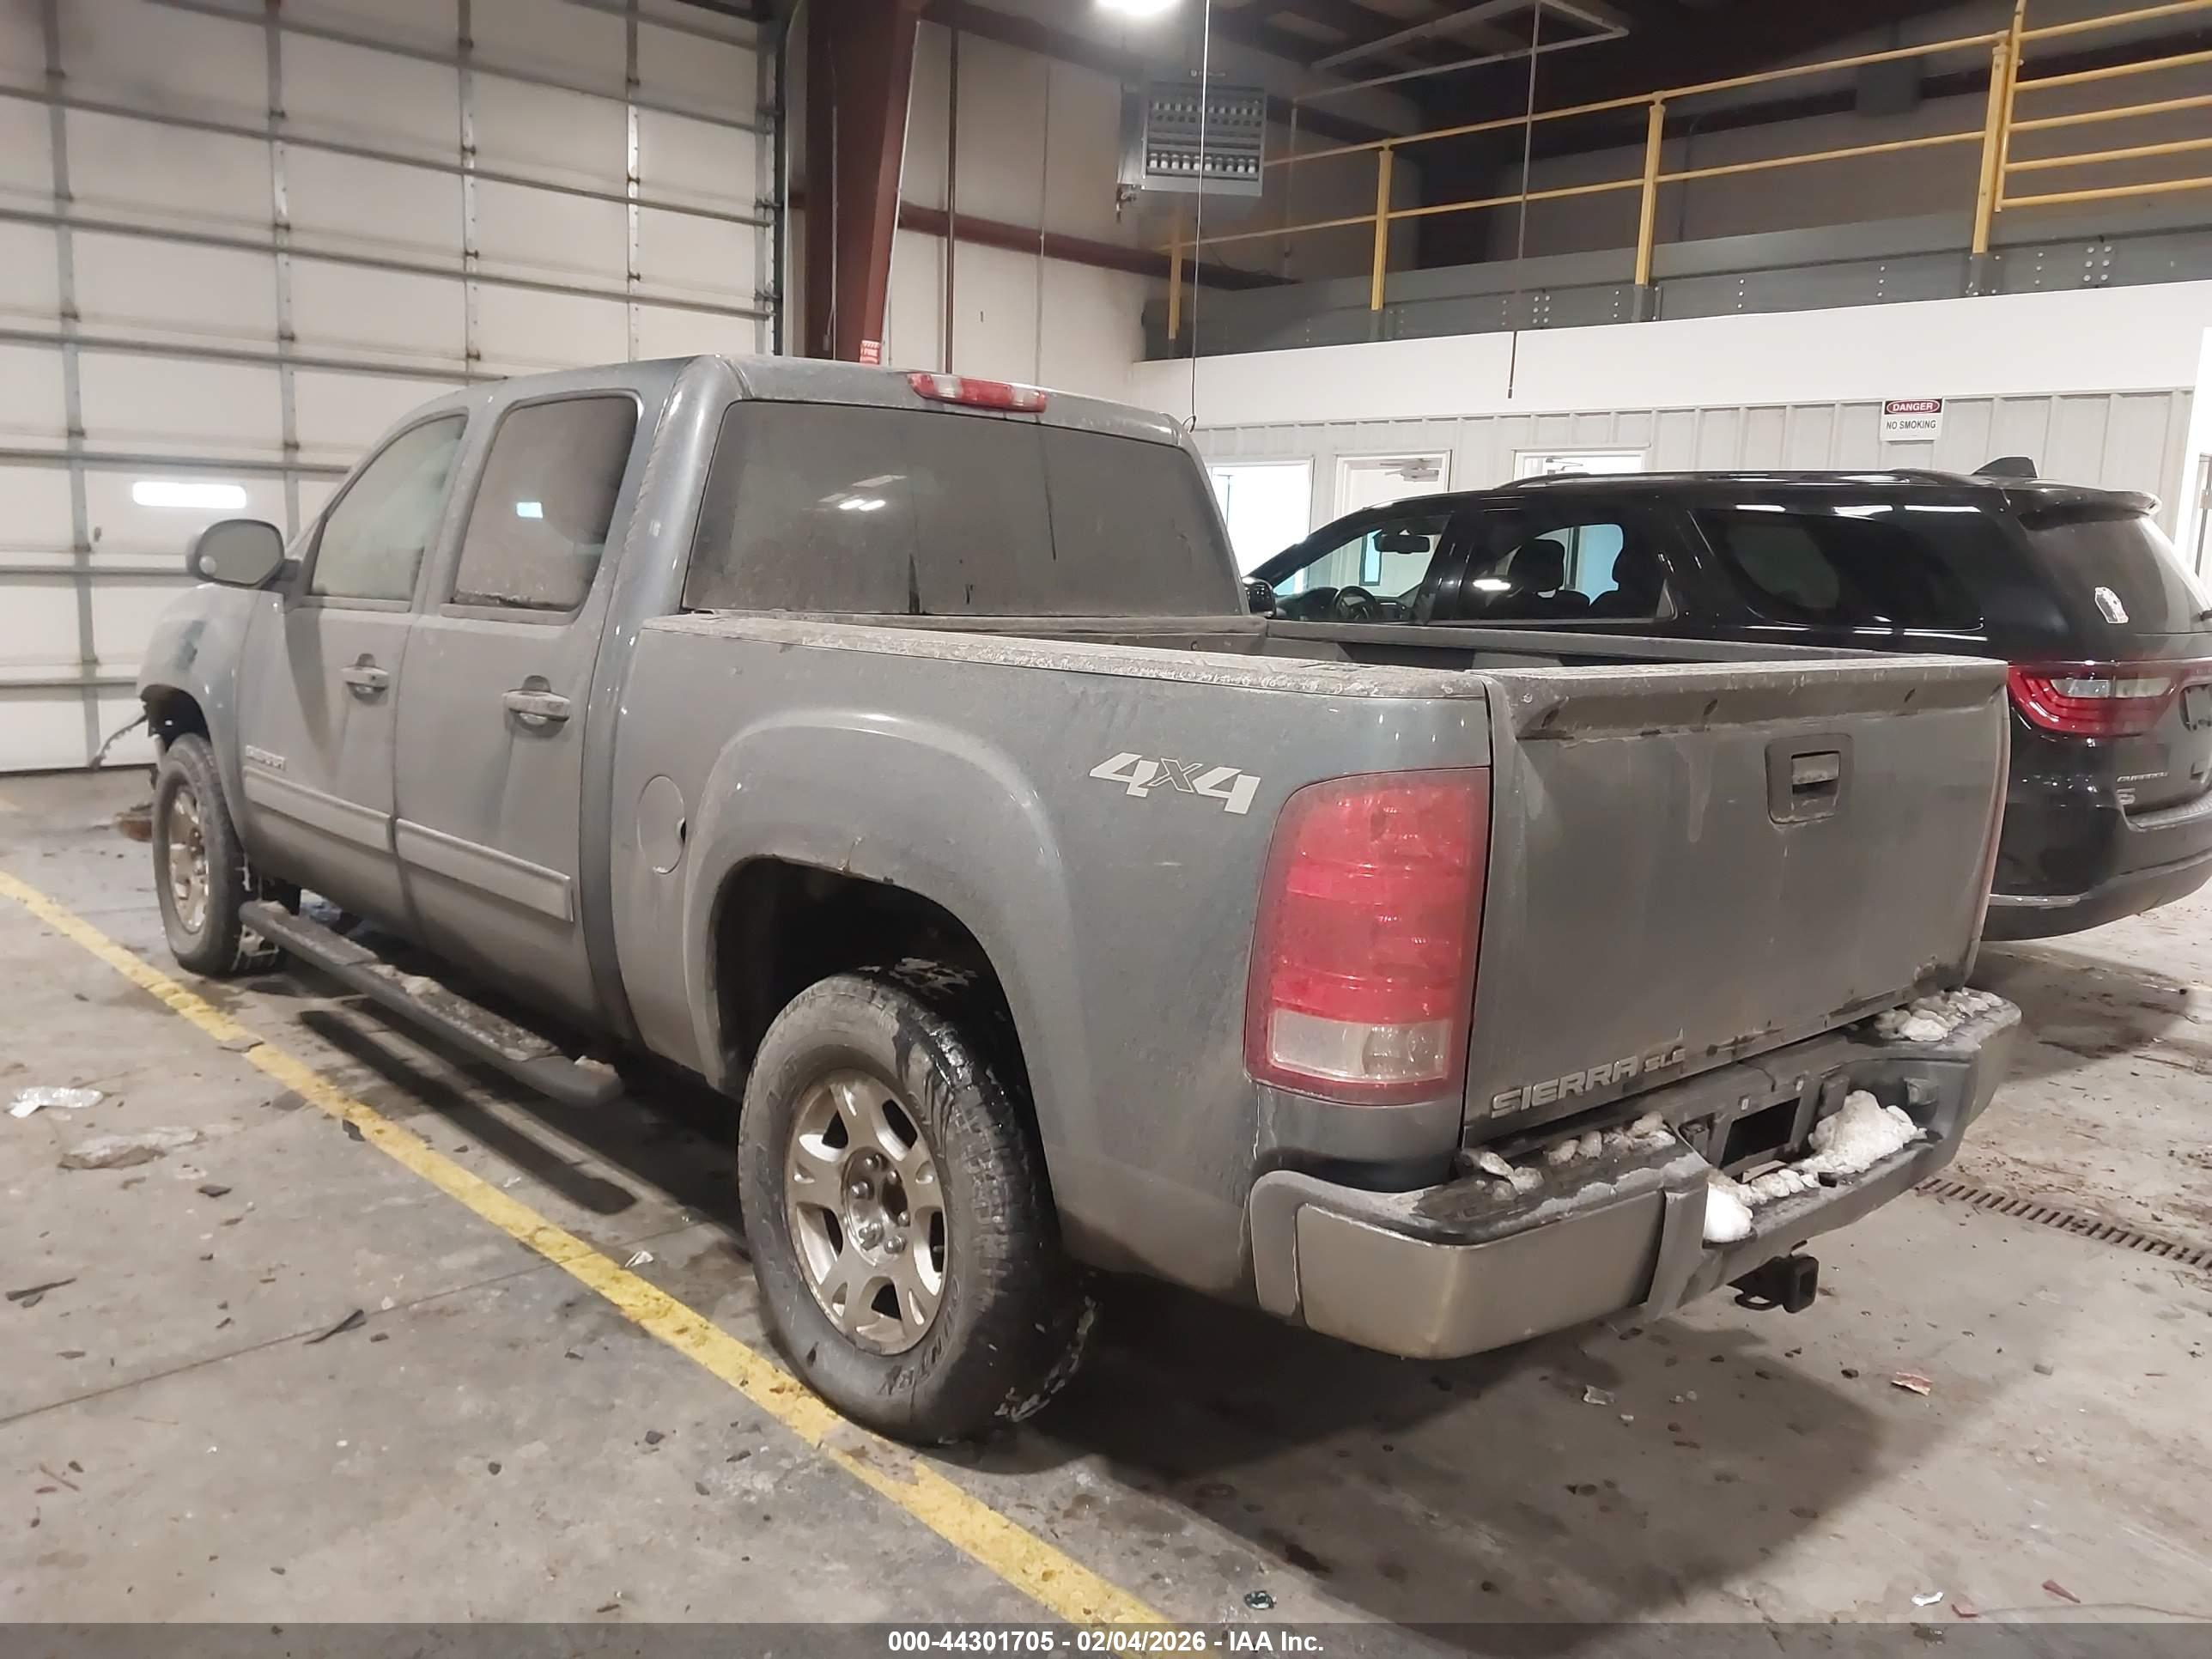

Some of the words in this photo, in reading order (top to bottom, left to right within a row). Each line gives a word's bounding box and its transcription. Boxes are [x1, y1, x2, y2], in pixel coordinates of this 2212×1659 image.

[1893, 402, 1934, 411] DANGER
[1886, 421, 1898, 430] NO
[1899, 419, 1936, 429] SMOKING
[1491, 1055, 1639, 1120] SIERRA
